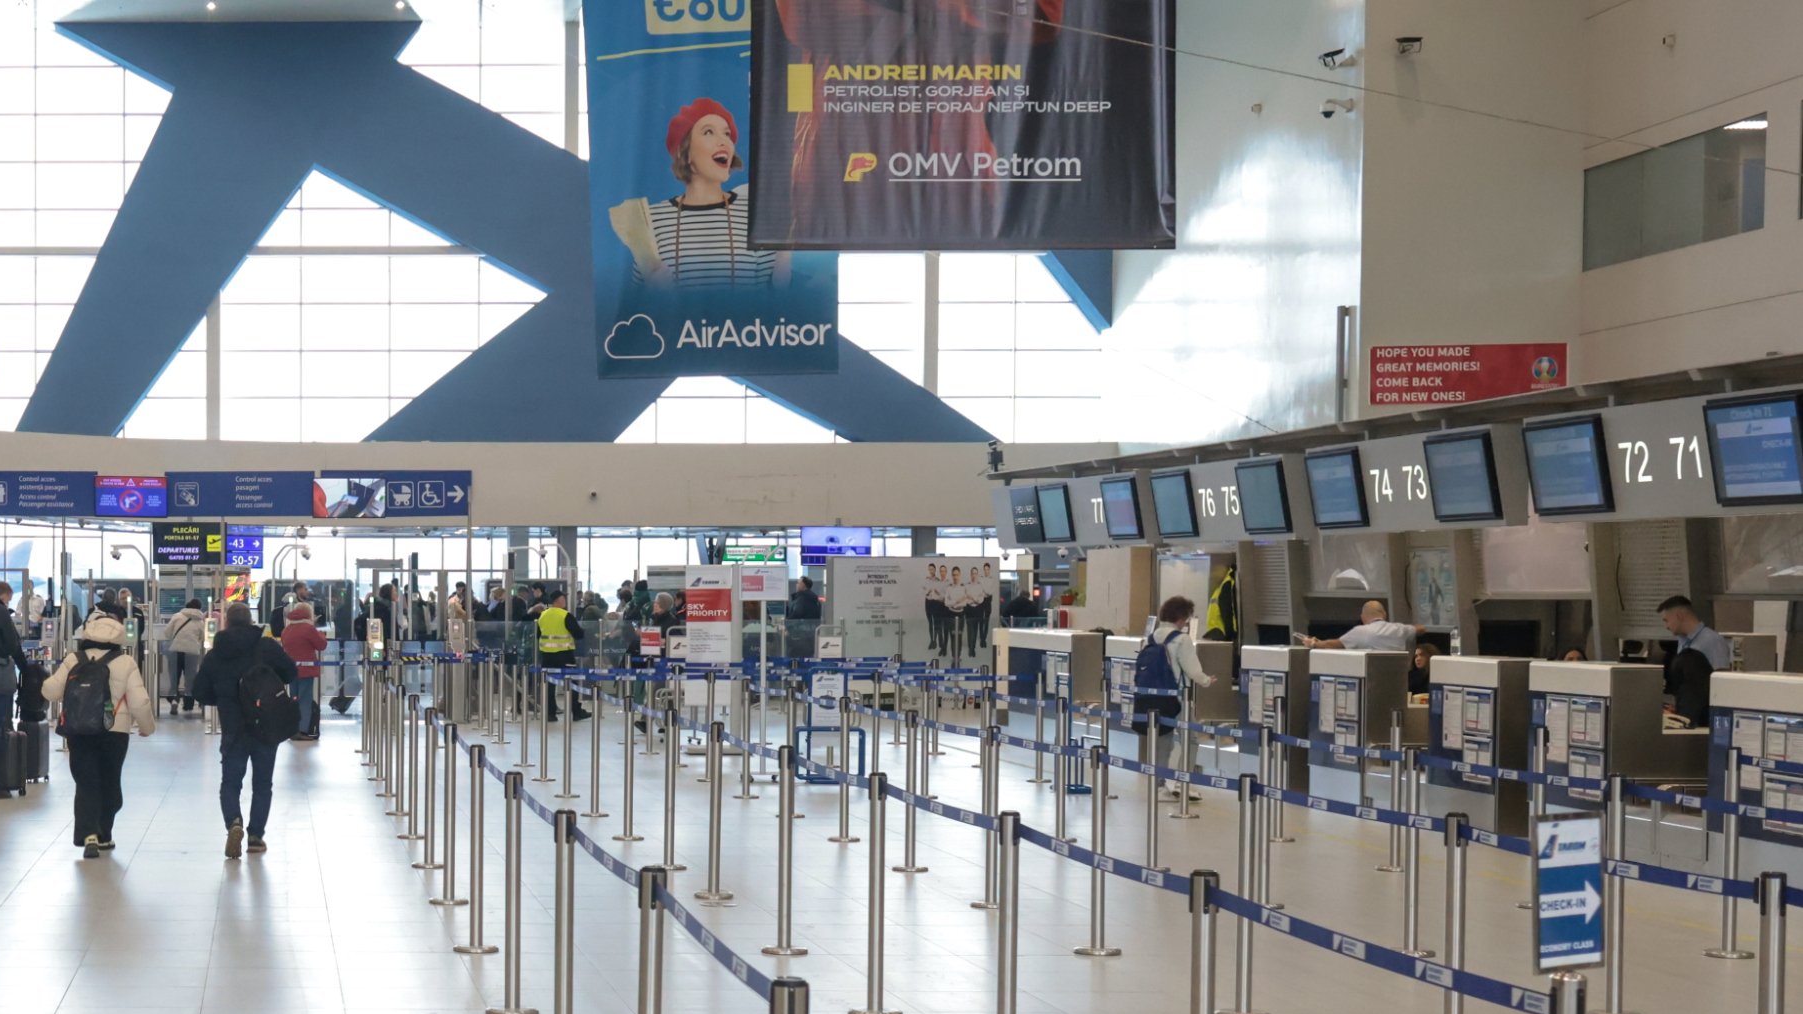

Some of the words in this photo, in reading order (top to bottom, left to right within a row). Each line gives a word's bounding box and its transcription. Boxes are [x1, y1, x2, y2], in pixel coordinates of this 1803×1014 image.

[653, 0, 746, 22] €60
[823, 64, 926, 81] ANDREI
[932, 64, 1022, 81] MARIN
[823, 85, 922, 98] PETROLIST,
[925, 85, 1010, 97] GORJEAN
[823, 101, 895, 113] INGINER
[899, 101, 923, 113] DE
[926, 101, 984, 113] FORAJ
[988, 101, 1060, 113] NEPTUN
[1064, 101, 1112, 113] DEEP
[889, 152, 962, 177] OMV
[974, 152, 1082, 176] Petrom
[676, 317, 832, 349] AirAdvisor
[1376, 347, 1408, 358] HOPE
[1411, 346, 1434, 357] YOU
[1437, 346, 1470, 357] MADE
[1376, 362, 1412, 373] GREAT
[1416, 361, 1480, 372] MEMORIES!
[1376, 377, 1409, 388] COME
[1412, 376, 1443, 387] BACK
[1376, 392, 1399, 402] FOR
[1402, 392, 1428, 402] NEW
[1431, 391, 1466, 401] ONES!
[1617, 440, 1653, 484] 72
[1669, 435, 1703, 480] 71
[45, 484, 69, 492] pasageri
[1370, 468, 1393, 503] 74
[1402, 464, 1427, 500] 73
[1198, 488, 1216, 517] 76
[1221, 486, 1240, 516] 75
[158, 546, 200, 554] DEPARTURES
[231, 555, 260, 566] 50-57
[687, 609, 728, 617] PRIORITY
[1540, 897, 1587, 912] CHECK-IN
[1573, 940, 1595, 951] CLASS
